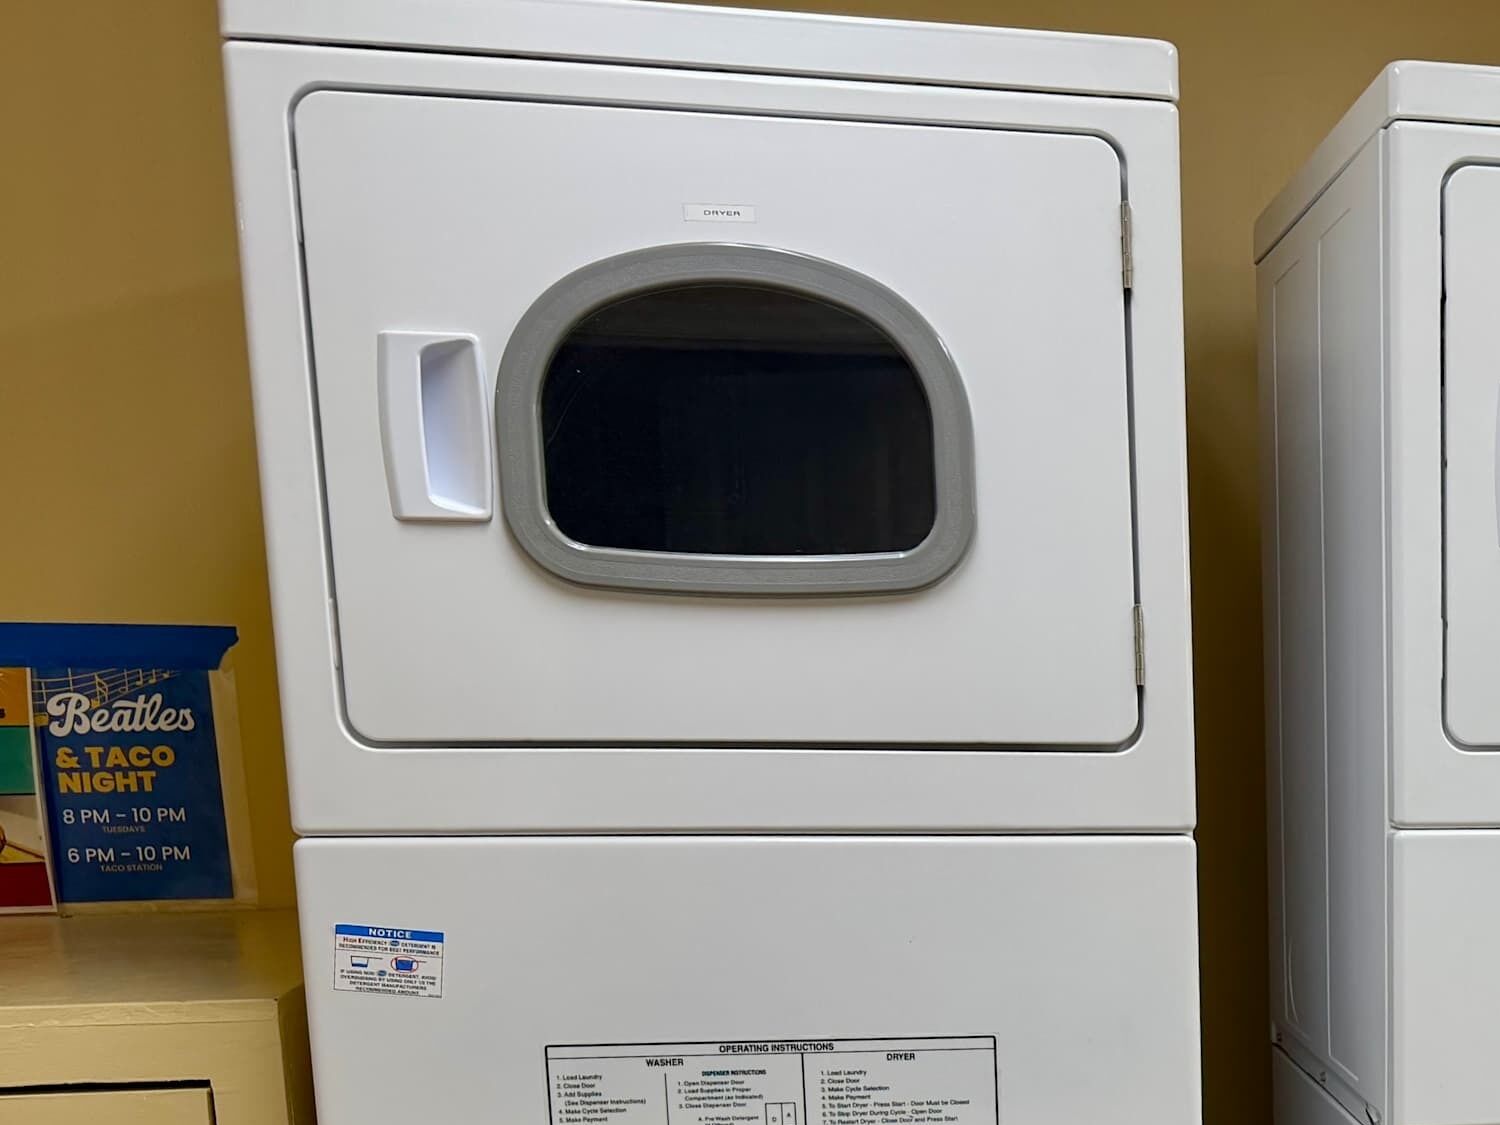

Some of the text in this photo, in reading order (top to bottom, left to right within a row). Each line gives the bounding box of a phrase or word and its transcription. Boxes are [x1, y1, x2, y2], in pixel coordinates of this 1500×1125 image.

[46, 692, 195, 737] Beatles
[55, 745, 175, 769] & TACO
[57, 771, 156, 793] NIGHT
[62, 809, 75, 824] 8
[80, 809, 110, 824] PM
[131, 807, 151, 823] 10
[157, 807, 186, 822] PM
[67, 847, 80, 863] 6
[85, 847, 115, 863] PM
[136, 846, 156, 862] 10
[161, 846, 191, 861] PM
[126, 864, 163, 872] STATION
[368, 928, 412, 939] NOTICE
[719, 1043, 834, 1053] OPERATING INSTRUCTIONS
[645, 1058, 684, 1067] WASHER
[886, 1053, 916, 1061] DRYER
